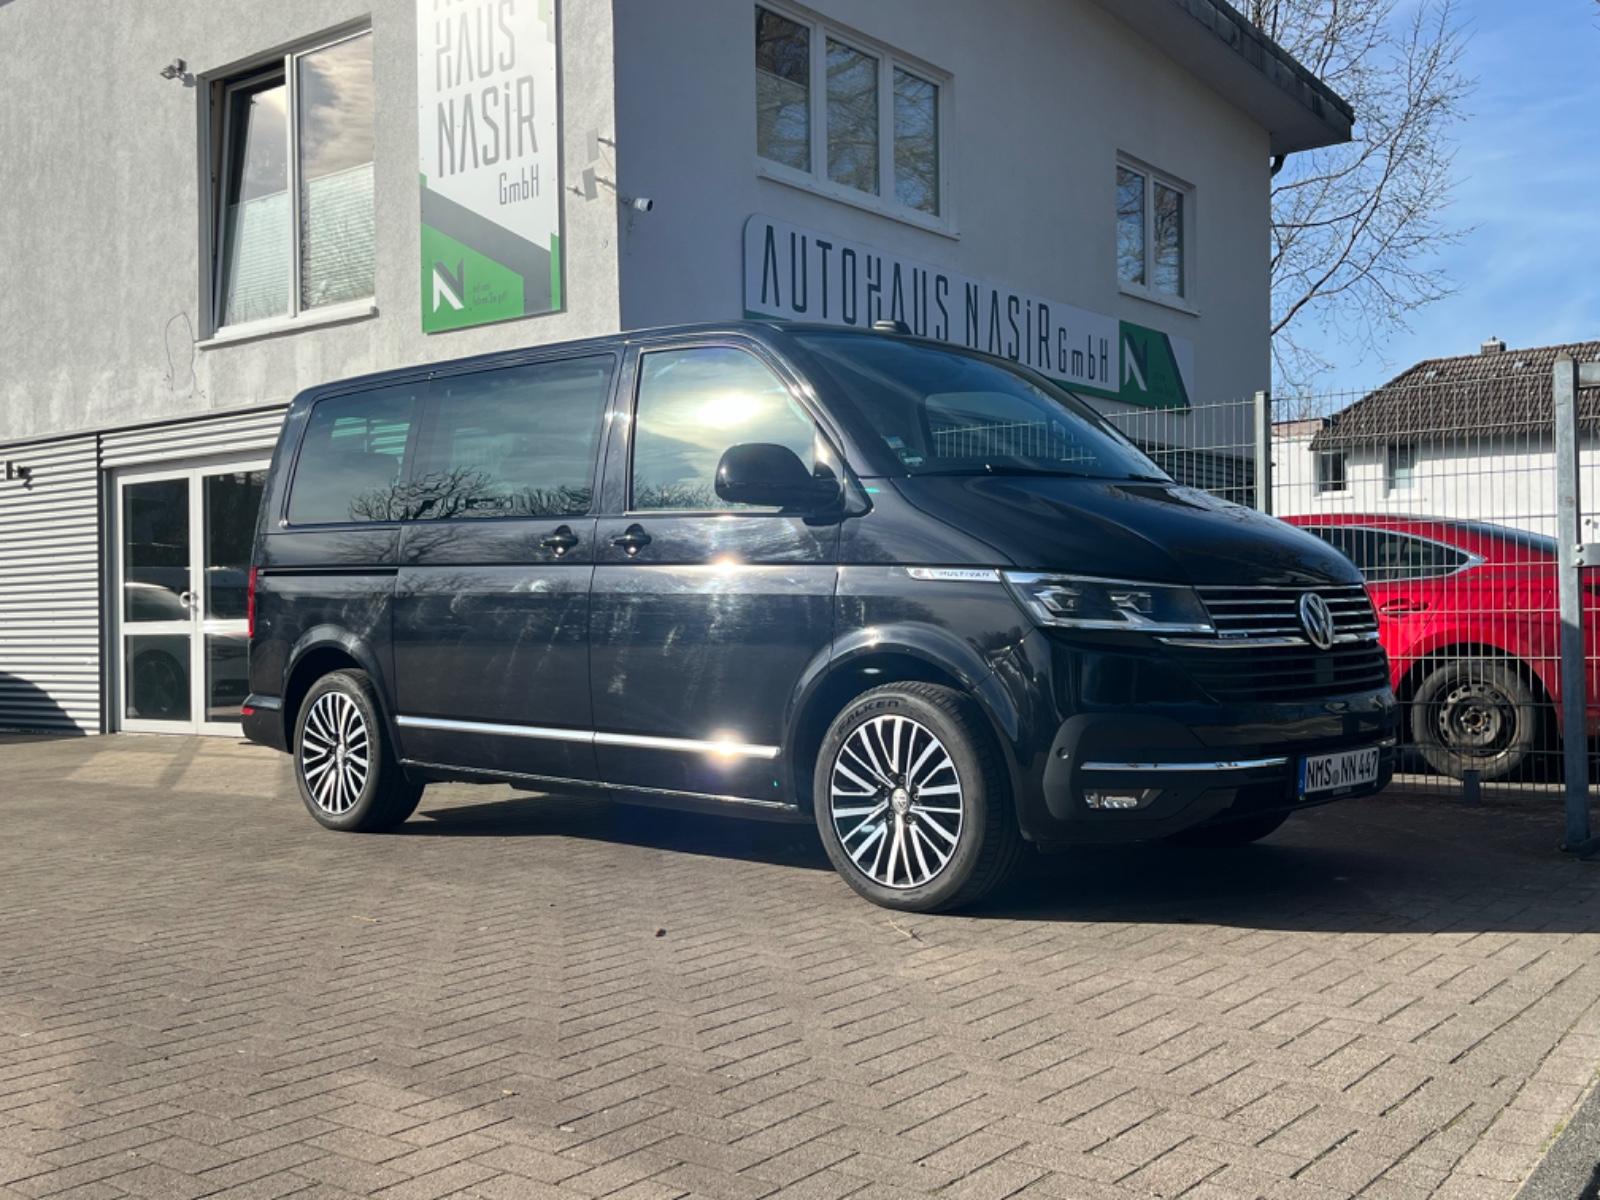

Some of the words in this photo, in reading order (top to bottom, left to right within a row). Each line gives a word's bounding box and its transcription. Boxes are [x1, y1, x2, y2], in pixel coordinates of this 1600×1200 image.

[499, 164, 540, 205] GmbH
[761, 224, 950, 342] AUTOHAUS
[1058, 326, 1109, 384] GmbH
[1306, 759, 1332, 789] NMS
[1341, 755, 1357, 783] NN
